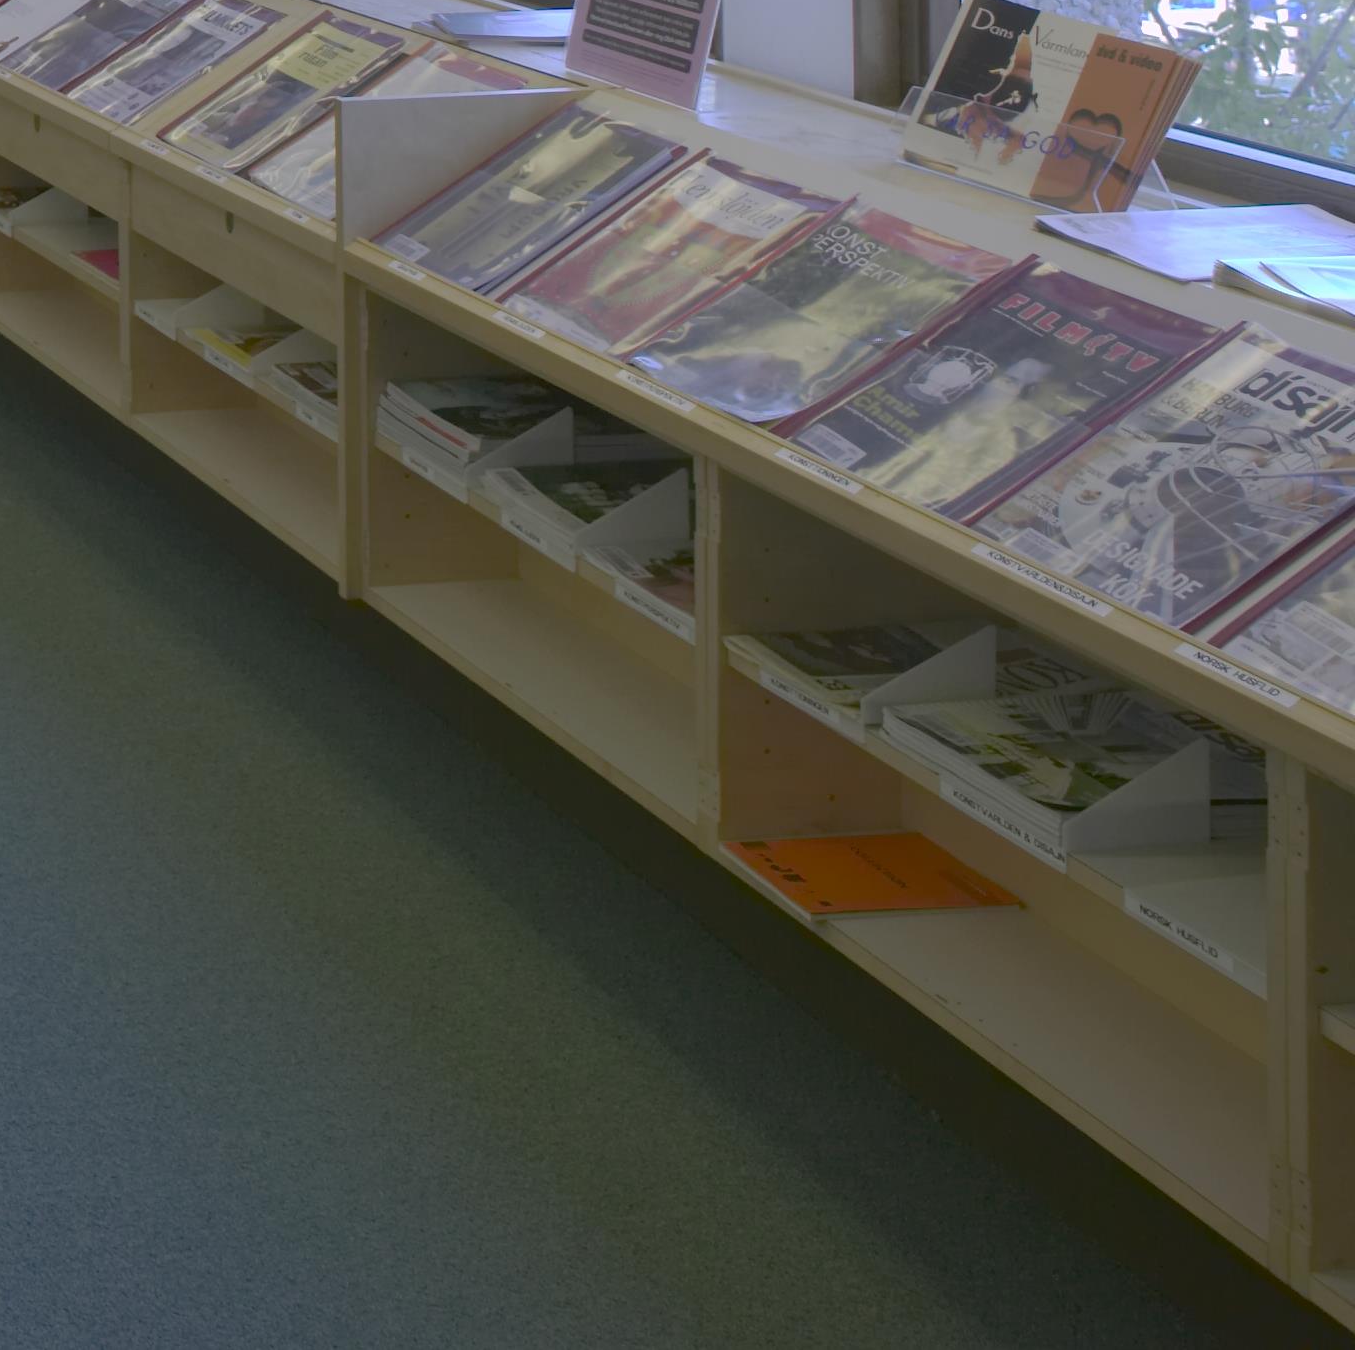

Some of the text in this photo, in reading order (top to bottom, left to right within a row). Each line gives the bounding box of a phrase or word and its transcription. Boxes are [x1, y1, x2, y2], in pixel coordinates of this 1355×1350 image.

[971, 7, 1015, 40] Dans
[1095, 42, 1116, 59] dvd
[1129, 52, 1164, 71] video
[1021, 129, 1077, 160] GOD
[1192, 650, 1231, 674] NORSK
[1233, 670, 1281, 698] HUSFLID
[1138, 904, 1220, 960] NORSK HUSFLID
